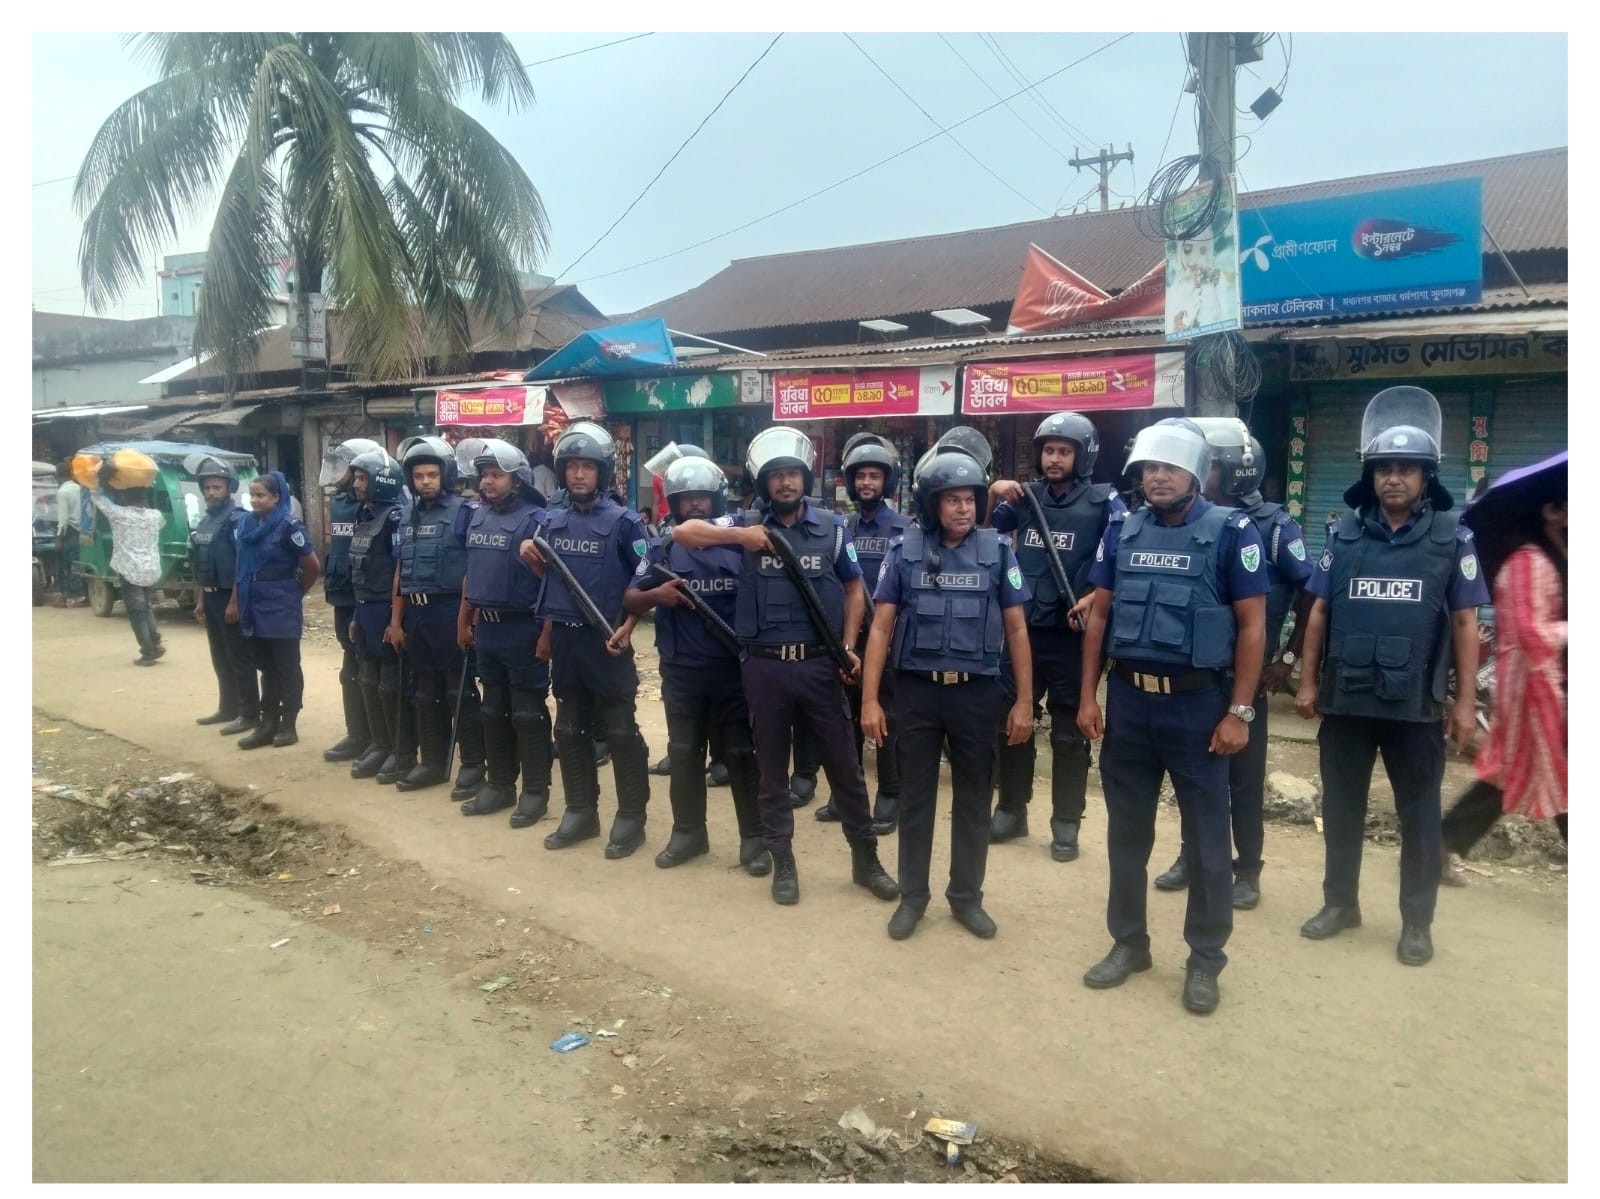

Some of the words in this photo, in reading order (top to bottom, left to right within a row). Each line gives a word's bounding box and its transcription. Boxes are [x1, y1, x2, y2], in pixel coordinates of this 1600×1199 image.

[1361, 228, 1415, 246] ইন্টারনেটে
[1271, 239, 1338, 259] গ্রামীণফোন
[1281, 298, 1324, 314] টেলিকম
[970, 375, 1008, 395] সুবিধা
[1015, 377, 1039, 395] ৫০
[1071, 380, 1104, 393] ১৪.৯০
[1112, 369, 1126, 392] ২
[779, 385, 809, 402] সুবিধা
[813, 387, 833, 403] ৫০
[887, 380, 898, 401] ২
[780, 400, 809, 415] ডাবল
[970, 393, 1008, 408] ডাবল
[375, 475, 397, 486] POLICE
[1233, 467, 1258, 478] OLICE
[332, 524, 354, 536] POLICE
[468, 532, 507, 548] POLICE
[554, 537, 599, 554] POLICE
[853, 538, 883, 552] OLICE
[1029, 530, 1068, 548] POCE
[761, 555, 822, 570] POCE
[1139, 554, 1181, 568] POLICE
[1357, 580, 1413, 598] POLICE
